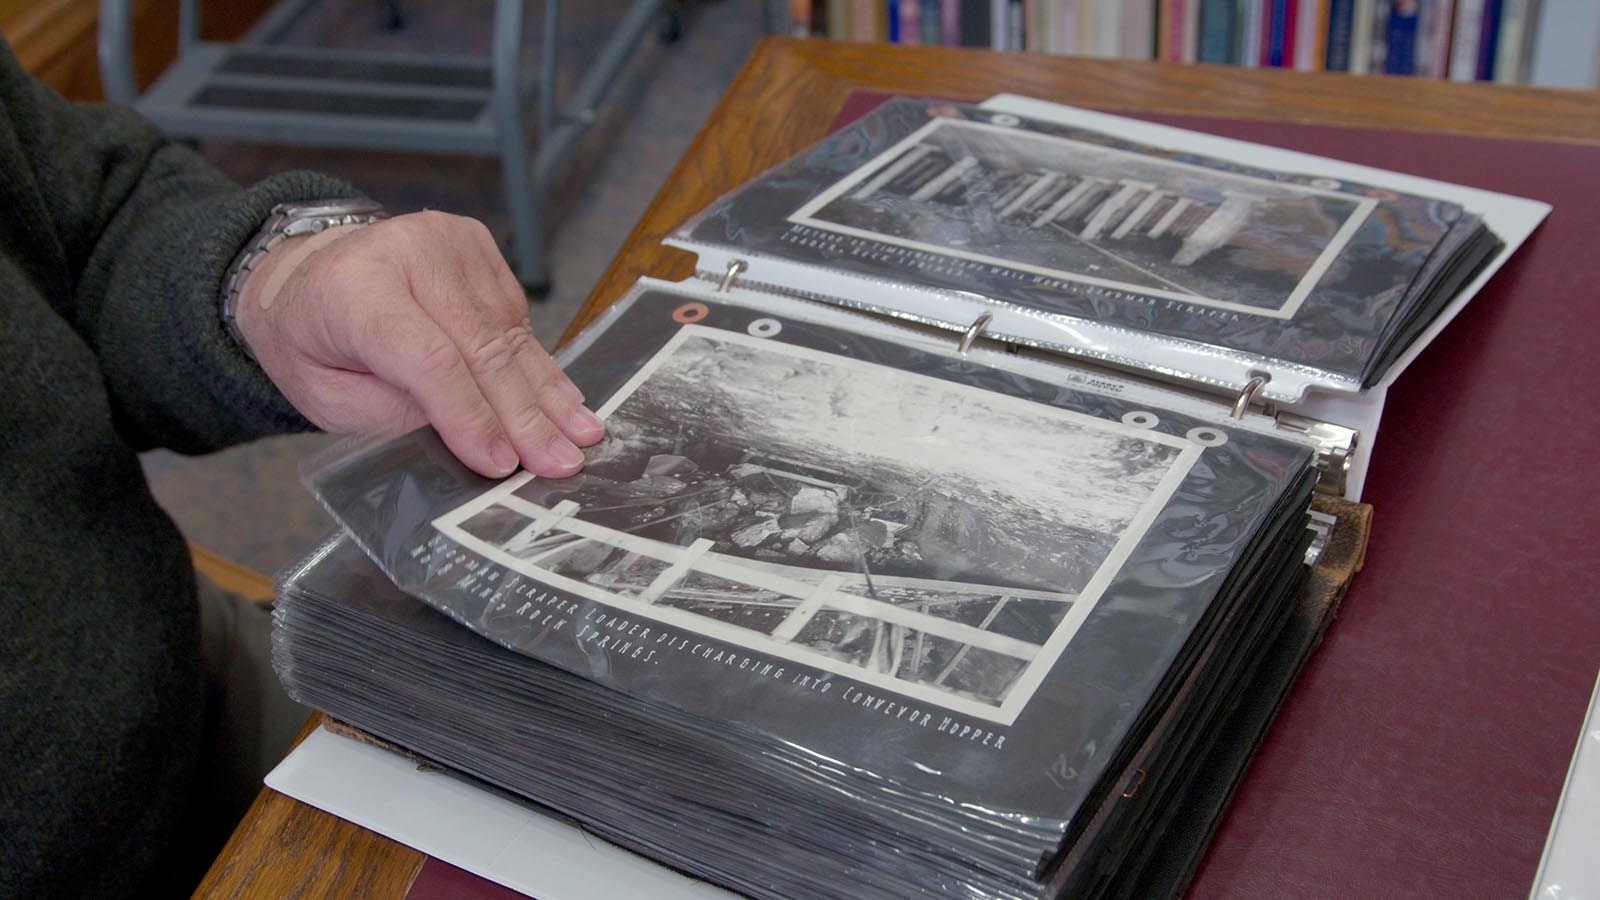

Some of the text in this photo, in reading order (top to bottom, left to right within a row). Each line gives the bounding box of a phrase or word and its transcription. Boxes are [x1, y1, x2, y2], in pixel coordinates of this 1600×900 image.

[1166, 301, 1240, 322] SCRAPER
[505, 575, 578, 615] SCRAPER
[585, 607, 651, 638] LOADER
[656, 632, 785, 679] DISCHARGING
[792, 672, 832, 693] INTO
[842, 686, 932, 727] CONVEYOR
[938, 717, 1006, 750] HOPPER
[516, 601, 568, 631] ROCK
[576, 624, 660, 665] SPRINGS.
